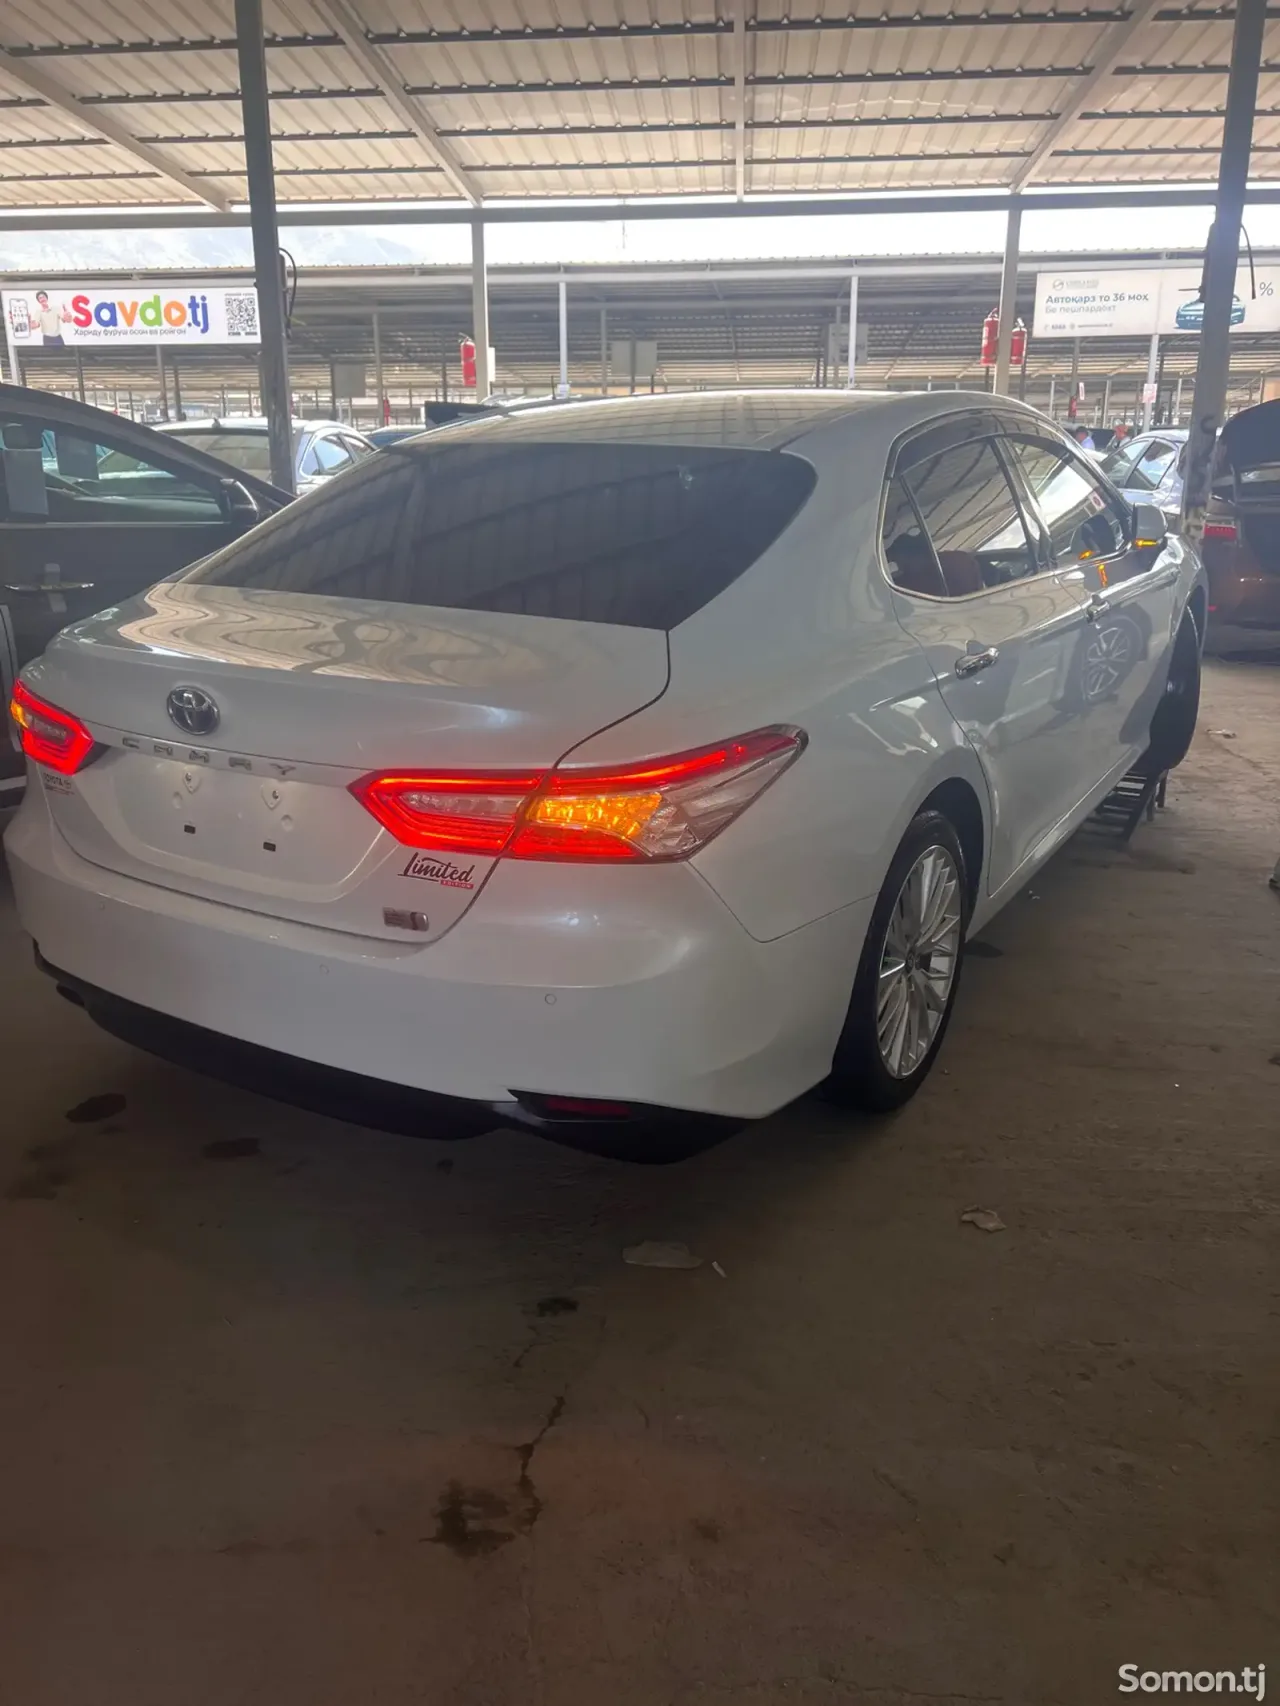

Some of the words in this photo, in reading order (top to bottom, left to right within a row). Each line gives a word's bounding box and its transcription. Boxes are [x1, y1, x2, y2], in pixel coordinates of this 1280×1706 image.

[1099, 294, 1111, 302] то
[1113, 292, 1125, 302] 36
[71, 294, 209, 334] Savdo.tj
[121, 736, 297, 775] CAMRY
[402, 852, 475, 878] Limited
